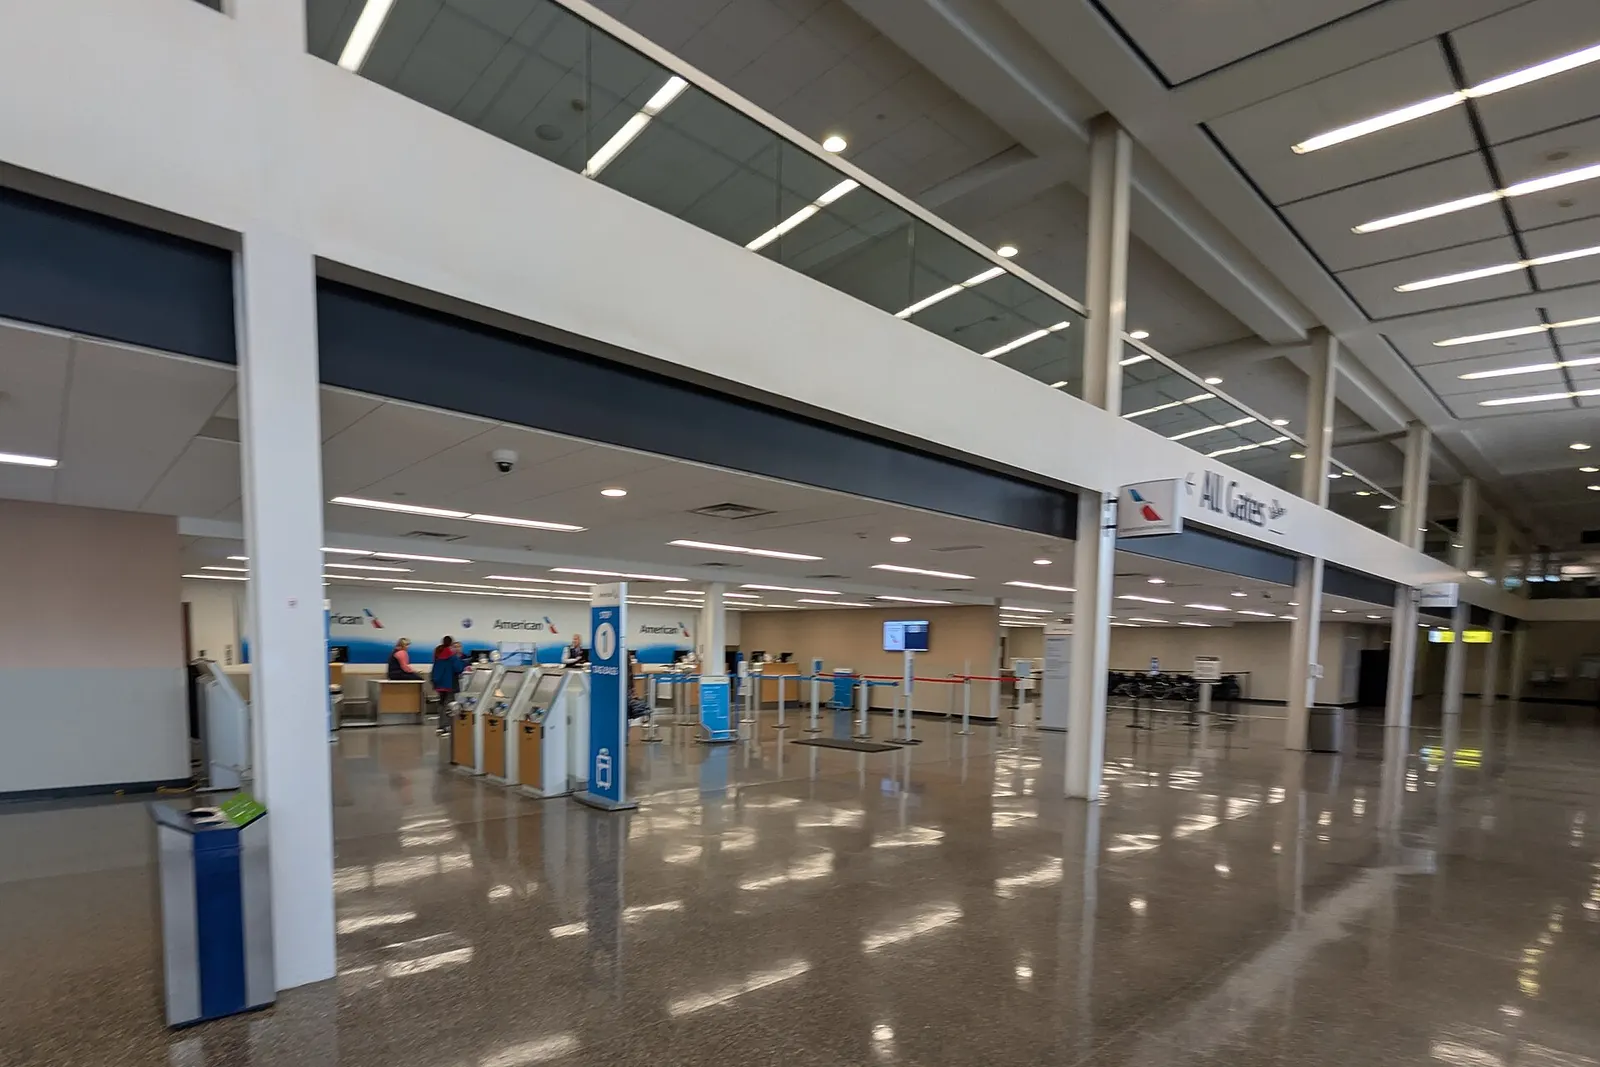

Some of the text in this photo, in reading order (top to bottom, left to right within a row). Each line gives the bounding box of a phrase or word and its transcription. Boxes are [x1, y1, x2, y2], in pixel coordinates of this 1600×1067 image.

[1199, 469, 1267, 527] All Gates
[329, 612, 364, 625] rican
[493, 619, 544, 630] American
[640, 624, 679, 635] American
[601, 630, 608, 653] 1
